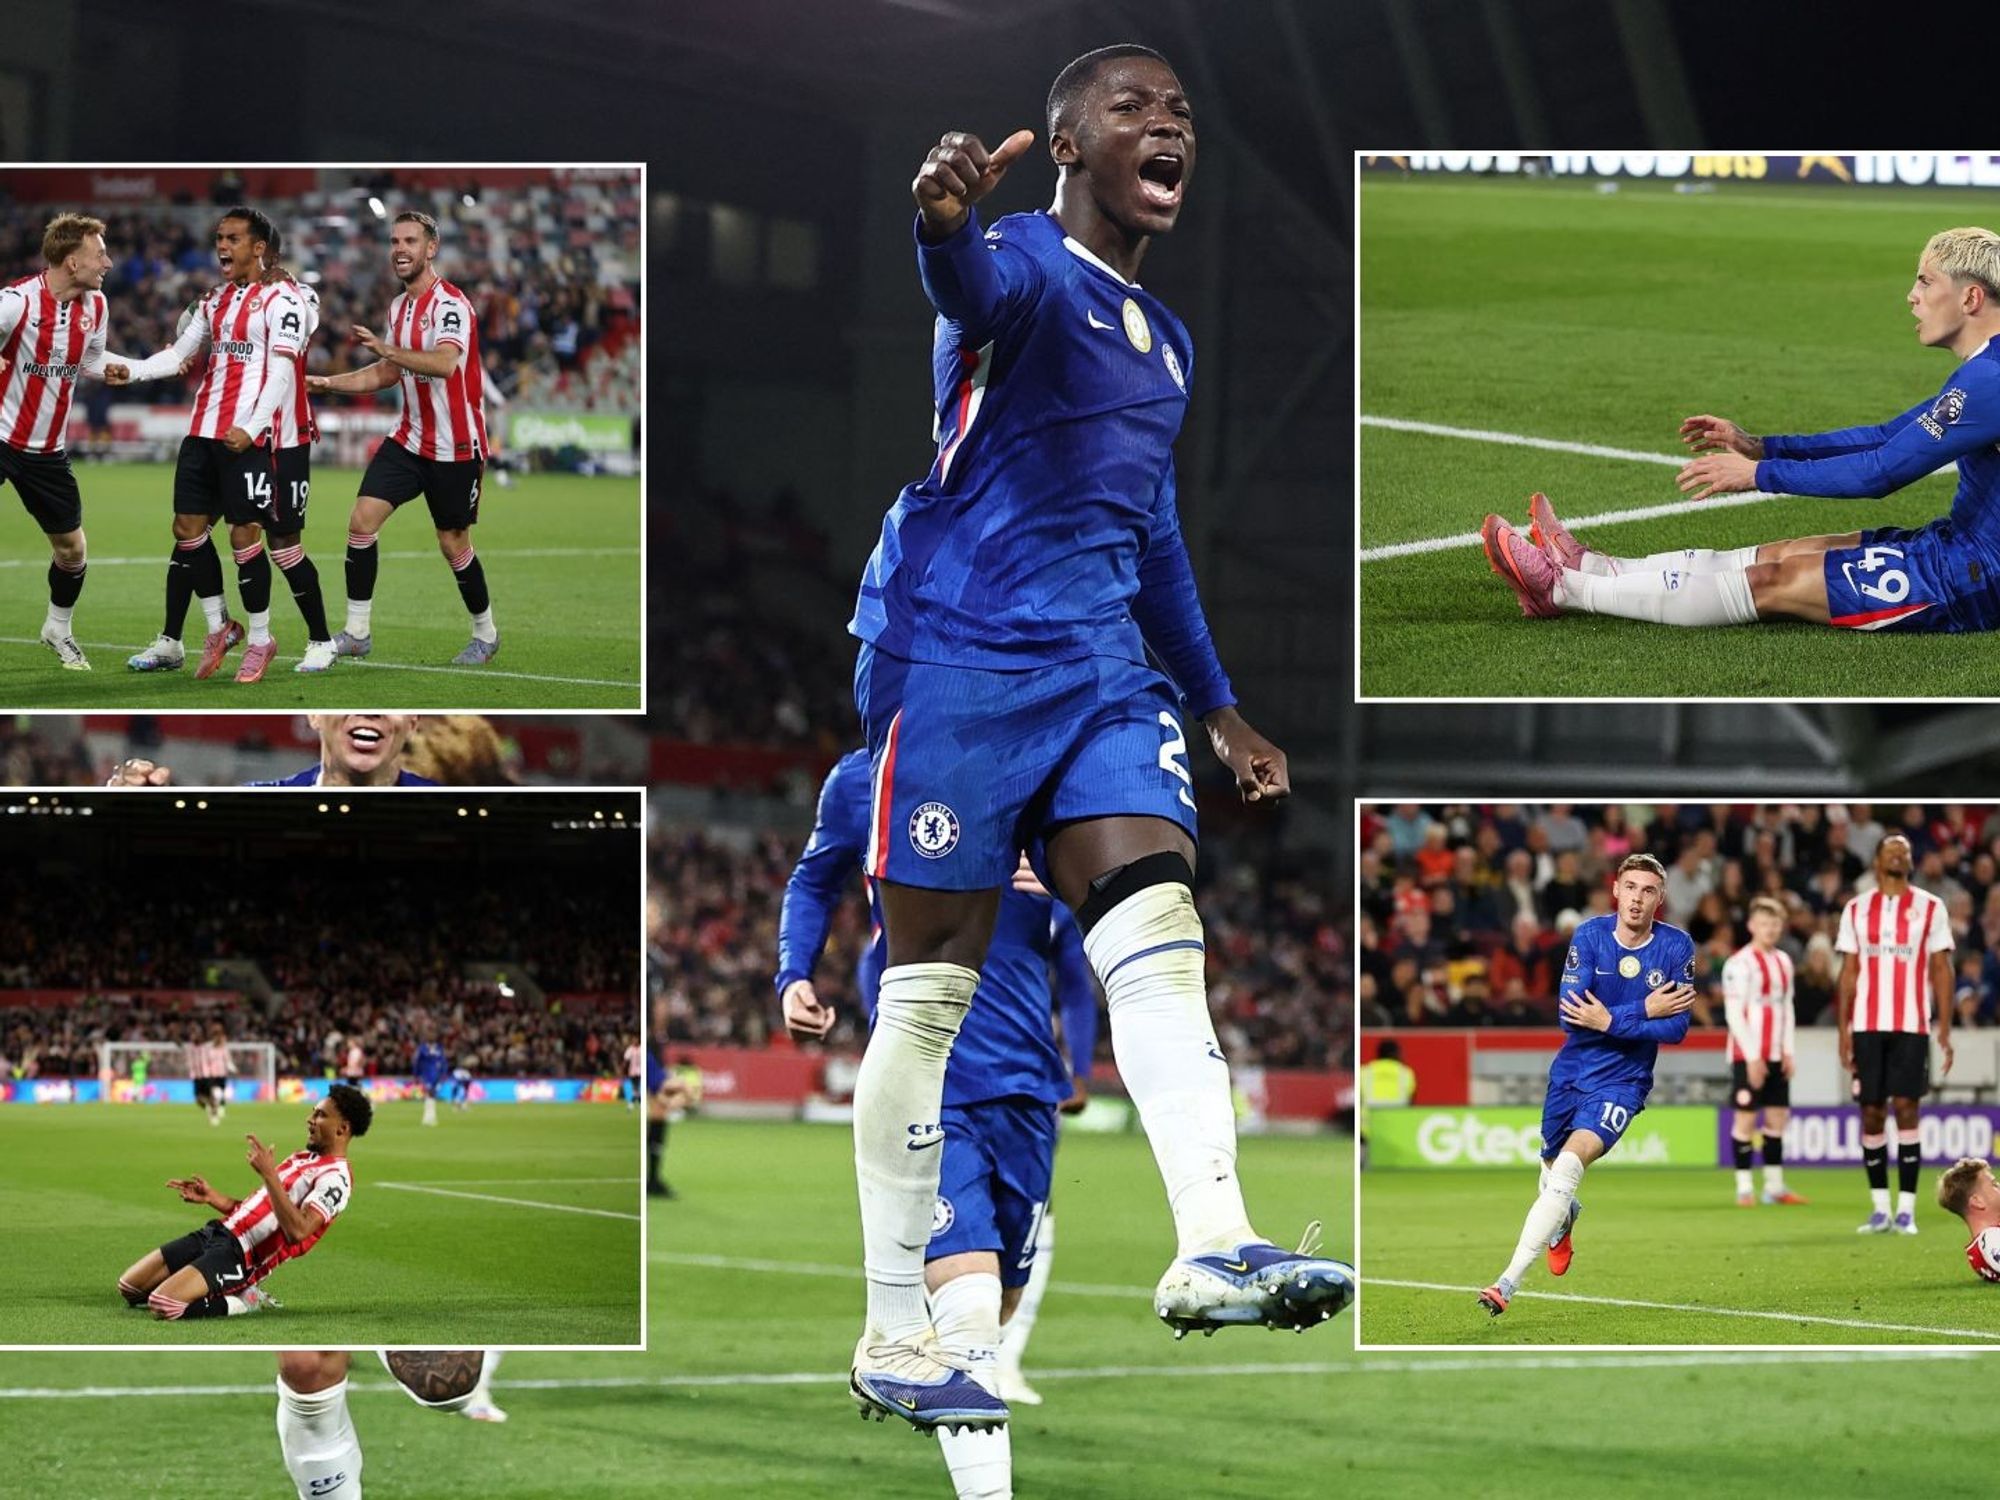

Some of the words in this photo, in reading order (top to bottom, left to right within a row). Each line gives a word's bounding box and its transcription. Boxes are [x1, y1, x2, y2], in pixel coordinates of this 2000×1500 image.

[22, 362, 79, 378] HOLLYWOO
[244, 472, 272, 500] 14
[290, 480, 309, 508] 19
[470, 478, 479, 503] 6
[1857, 547, 1910, 602] 49
[918, 803, 951, 818] CHELSEA
[1601, 1101, 1628, 1133] 10
[1781, 1114, 1992, 1161] HOLLOOD
[1021, 1202, 1045, 1254] 1
[222, 1263, 244, 1281] 7
[310, 1471, 346, 1488] CFC
